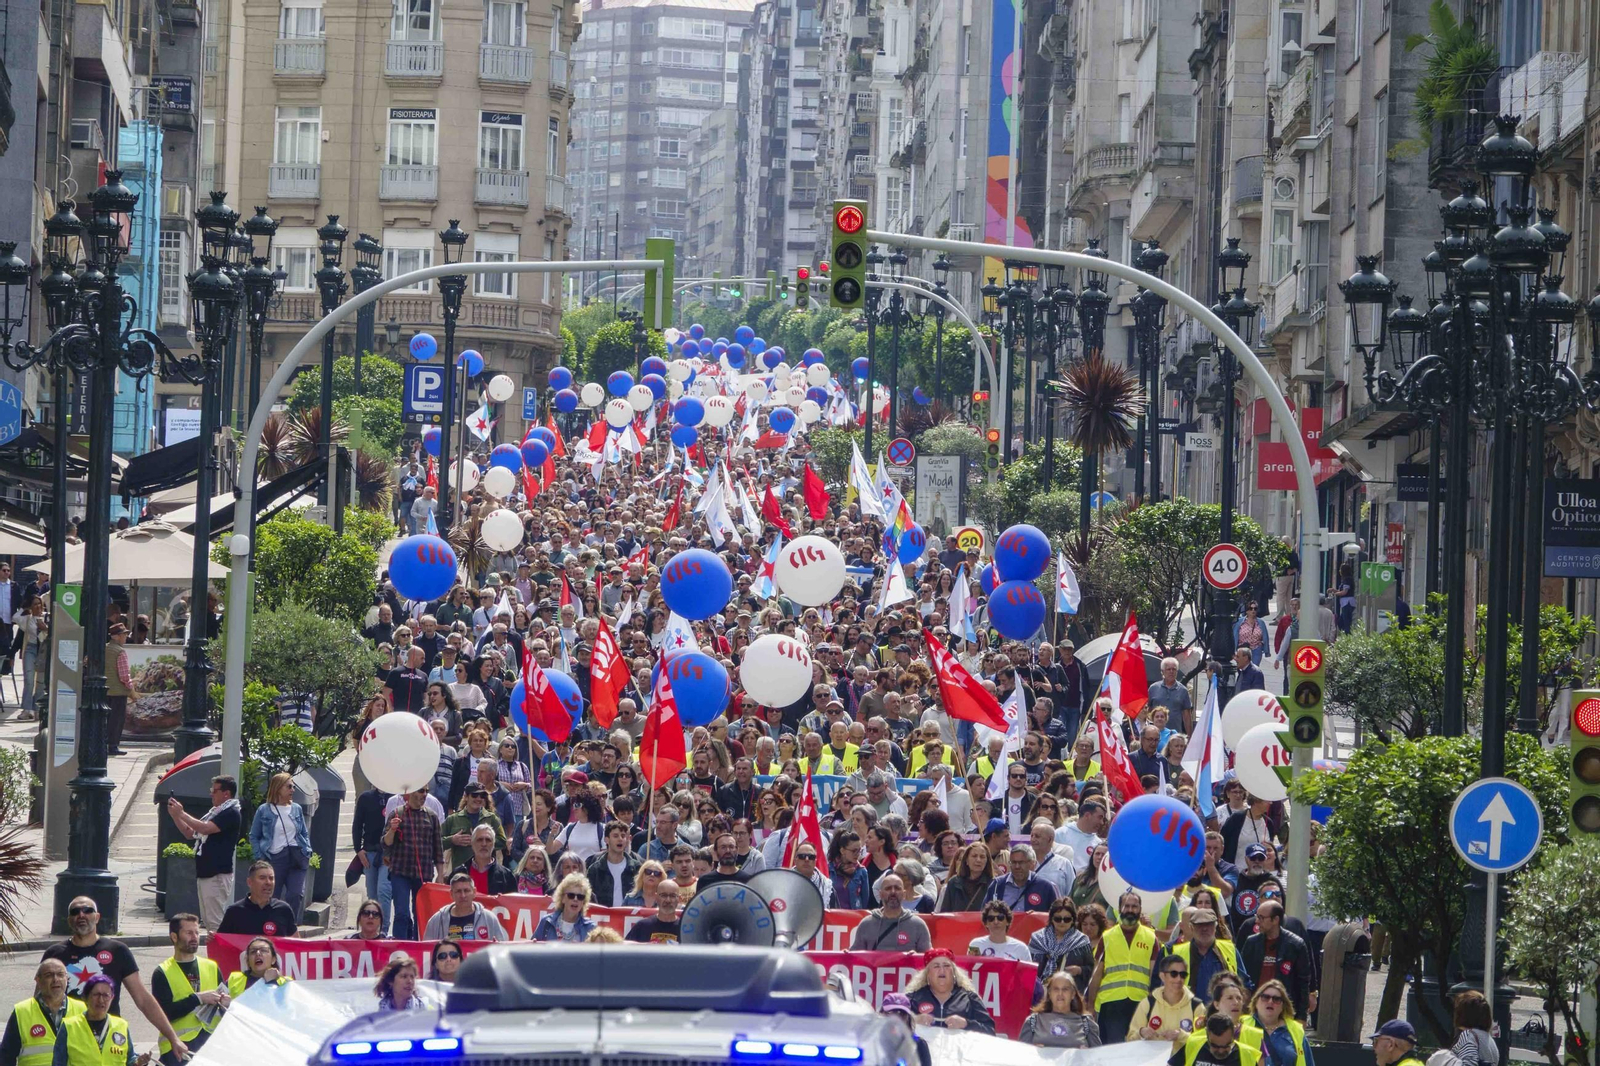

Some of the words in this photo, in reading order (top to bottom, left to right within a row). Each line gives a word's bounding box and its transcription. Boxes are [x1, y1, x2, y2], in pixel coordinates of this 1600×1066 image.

[392, 110, 434, 118] FISIOTERAPIA
[412, 339, 429, 351] CIG
[418, 371, 441, 398] P
[527, 391, 533, 404] P
[638, 388, 652, 396] CIG
[612, 401, 624, 410] CIG
[709, 400, 725, 408] CIG
[1190, 436, 1212, 445] hoss
[1557, 492, 1597, 508] Ulloa
[961, 536, 978, 547] 20
[1000, 532, 1028, 557] CIG
[417, 543, 453, 568] CIG
[789, 546, 826, 568] CIG
[667, 558, 702, 583] CIG
[1212, 558, 1239, 574] 40
[1007, 586, 1041, 606] CIG
[777, 640, 808, 667] CIG
[1151, 807, 1199, 857] CIG
[682, 887, 770, 934] COLLAZO
[1136, 941, 1149, 950] CIG
[100, 953, 110, 961] CIG
[32, 1027, 43, 1035] CIG
[110, 1046, 123, 1056] CIG
